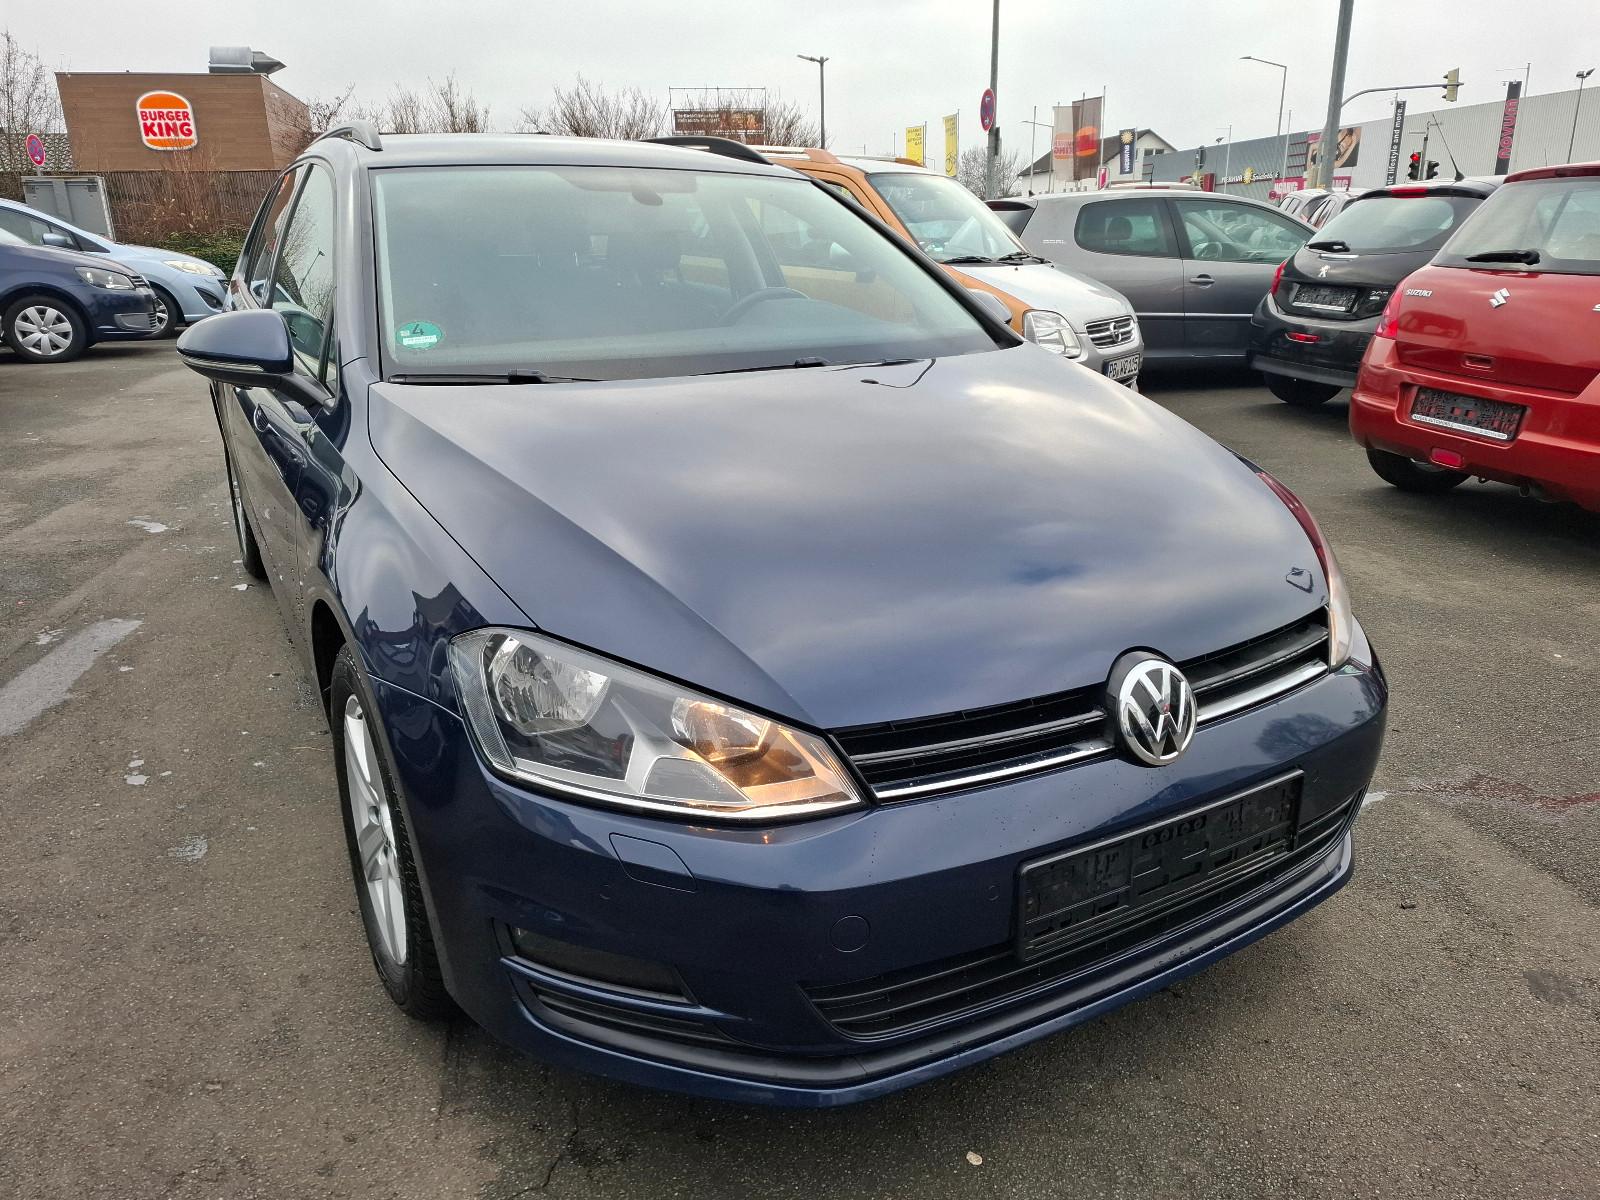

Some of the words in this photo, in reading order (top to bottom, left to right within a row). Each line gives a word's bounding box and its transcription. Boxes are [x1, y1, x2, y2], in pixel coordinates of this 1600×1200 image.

[140, 110, 190, 121] BURGER
[143, 122, 193, 137] KING
[1405, 288, 1433, 297] SUZUKI
